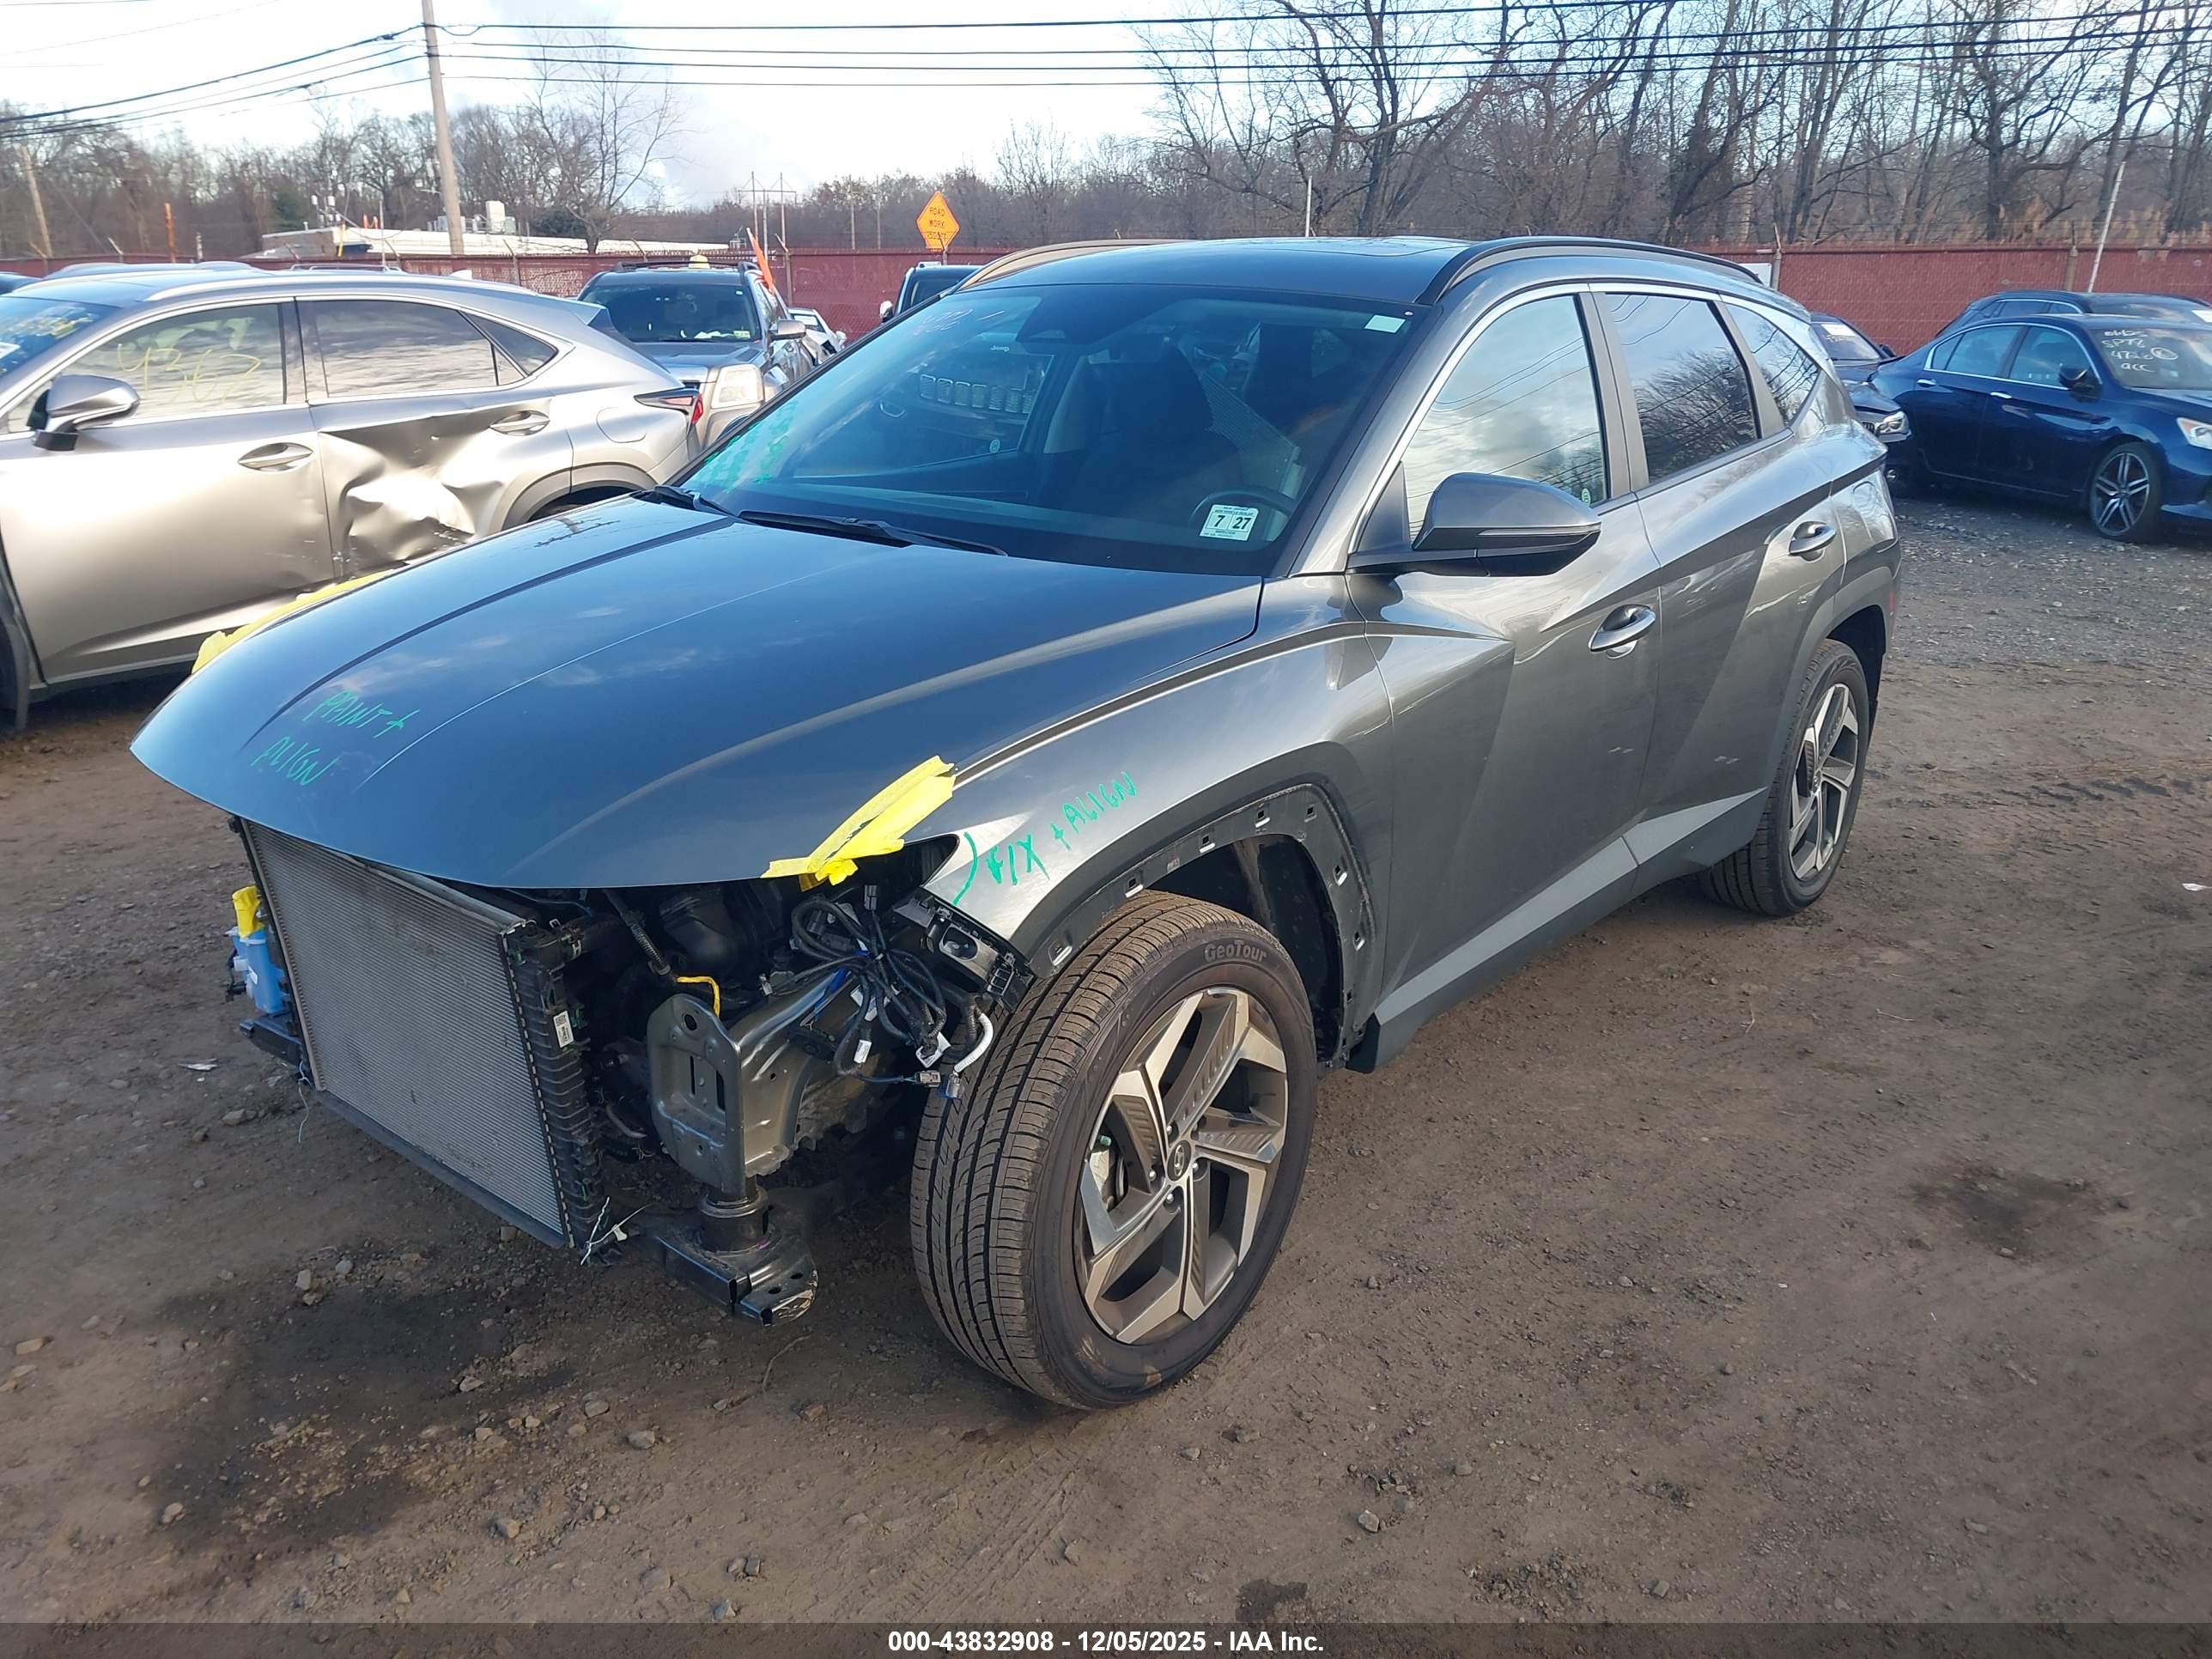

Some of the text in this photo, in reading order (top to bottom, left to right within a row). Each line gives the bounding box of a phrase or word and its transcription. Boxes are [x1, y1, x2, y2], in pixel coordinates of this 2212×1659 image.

[929, 207, 945, 216] ROAD
[1214, 514, 1252, 530] 7 27
[302, 690, 393, 728] PAINT
[986, 834, 1050, 886] FIX
[1062, 771, 1138, 834] ALIGN
[1204, 939, 1267, 963] GeoTour
